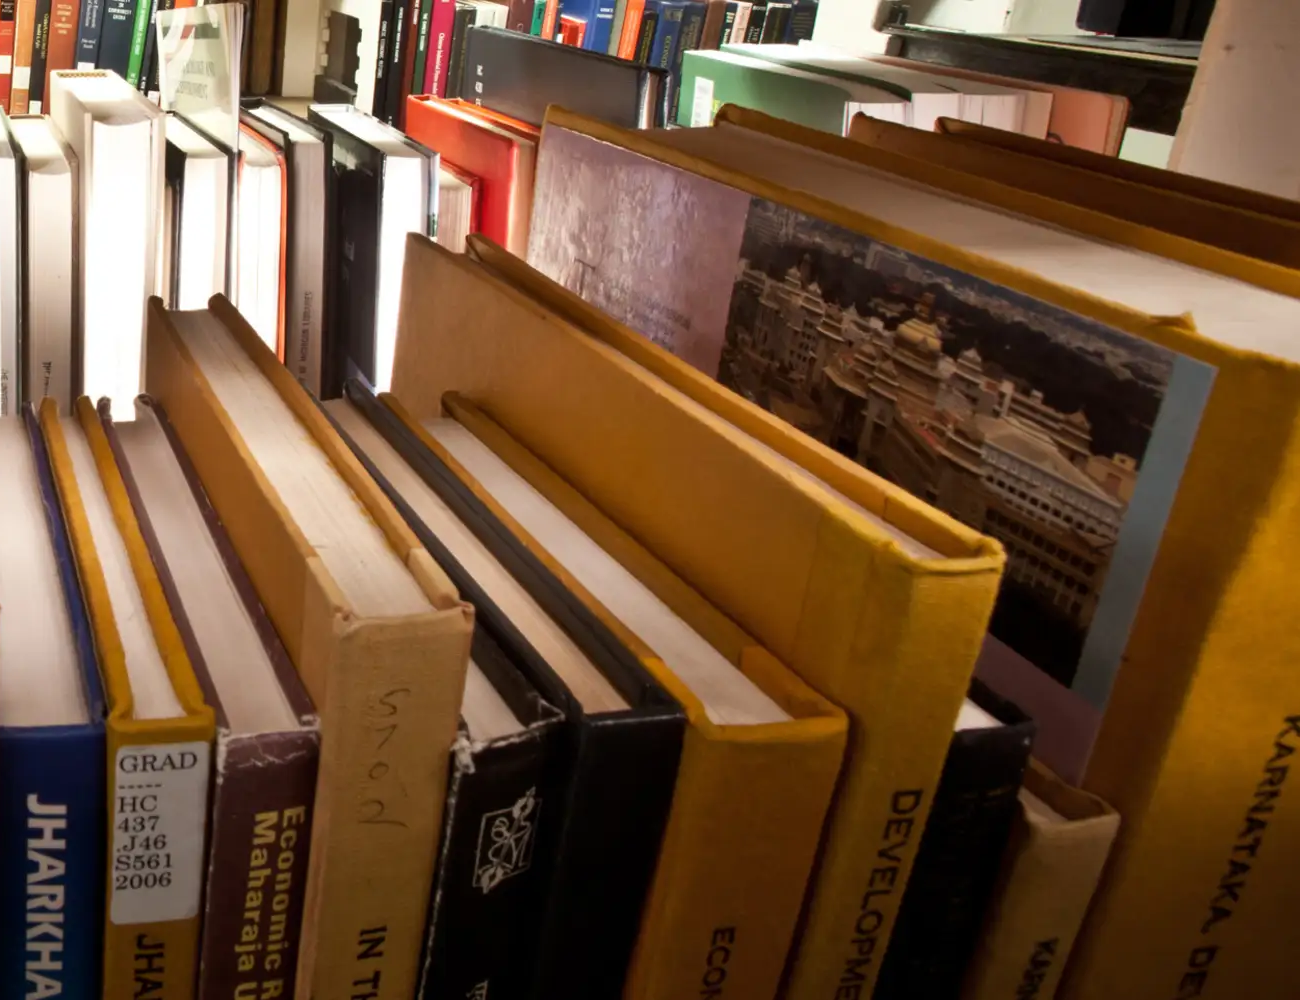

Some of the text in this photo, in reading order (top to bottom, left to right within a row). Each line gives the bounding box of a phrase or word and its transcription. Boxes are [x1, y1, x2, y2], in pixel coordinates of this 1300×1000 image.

[118, 752, 198, 773] GRAD
[118, 795, 158, 813] HC
[117, 816, 160, 833] 437
[116, 834, 167, 852] .J46
[114, 853, 173, 871] S561
[114, 872, 172, 890] 2006
[266, 805, 306, 972] Economic
[234, 811, 279, 972] Maharaja
[356, 925, 388, 961] IN
[133, 933, 165, 1000] JHA
